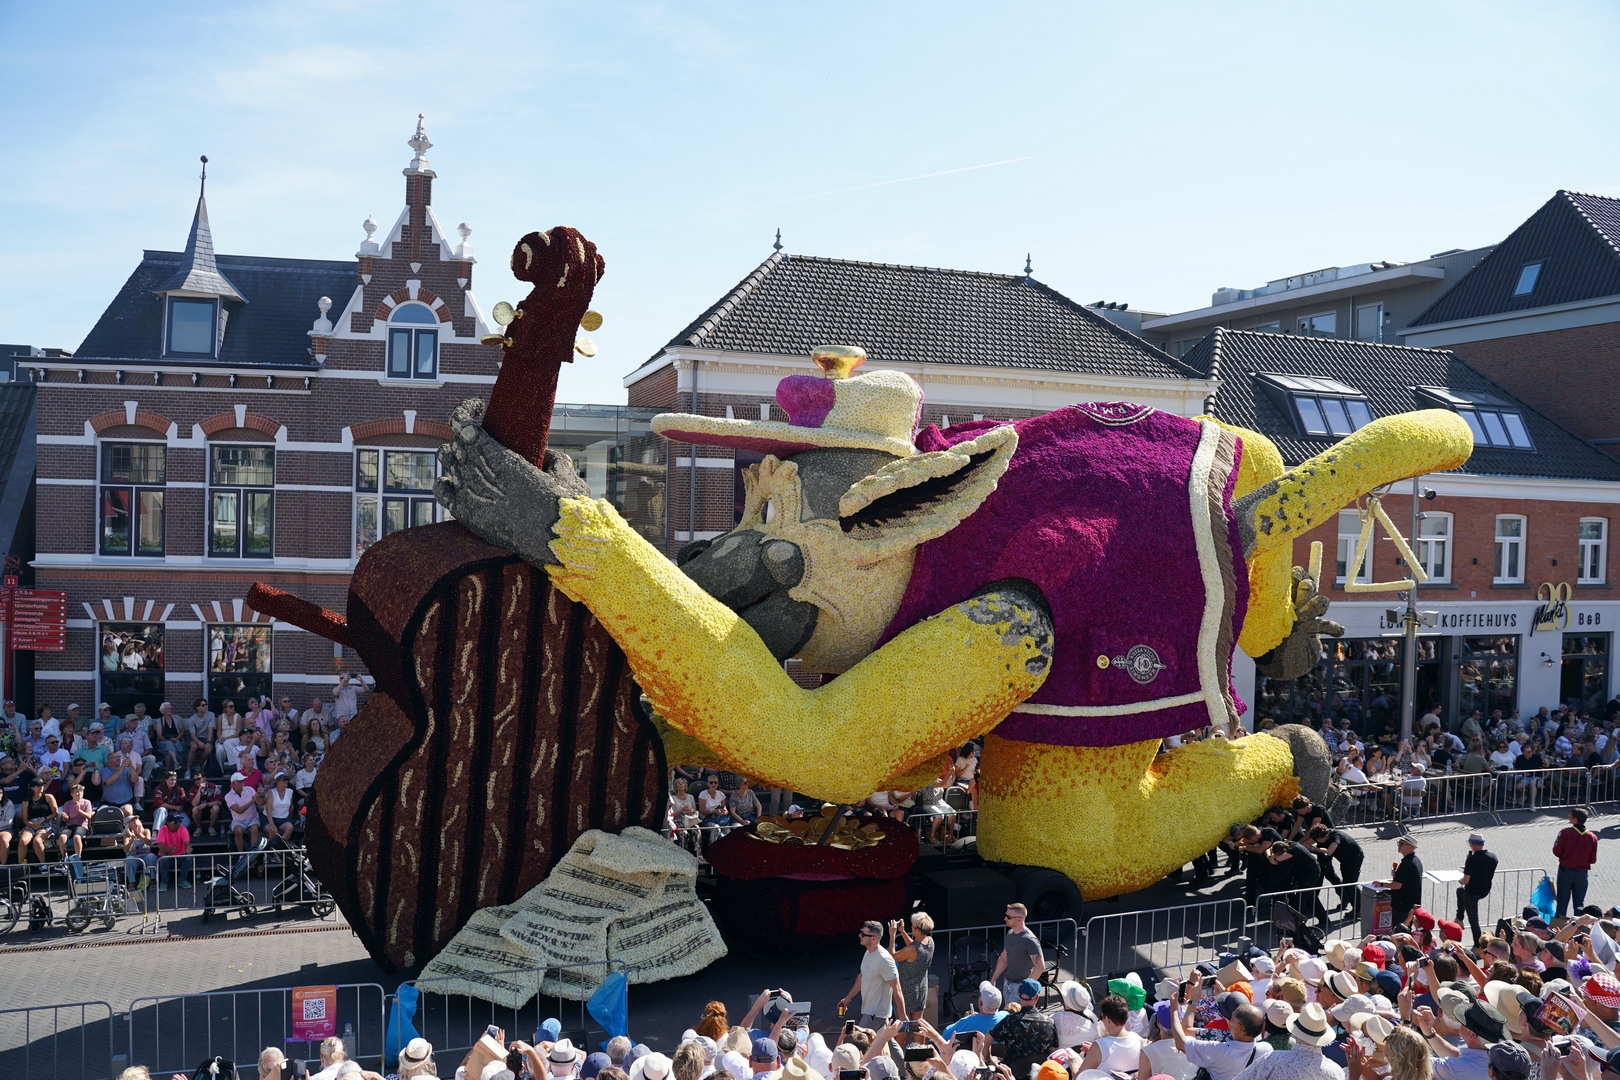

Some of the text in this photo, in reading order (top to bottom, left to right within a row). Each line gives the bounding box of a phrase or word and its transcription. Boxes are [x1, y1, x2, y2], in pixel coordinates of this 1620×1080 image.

[1529, 600, 1565, 637] Markt
[1537, 582, 1572, 632] 28
[1442, 613, 1517, 628] KOFFIEHUYS
[530, 930, 558, 946] BACH
